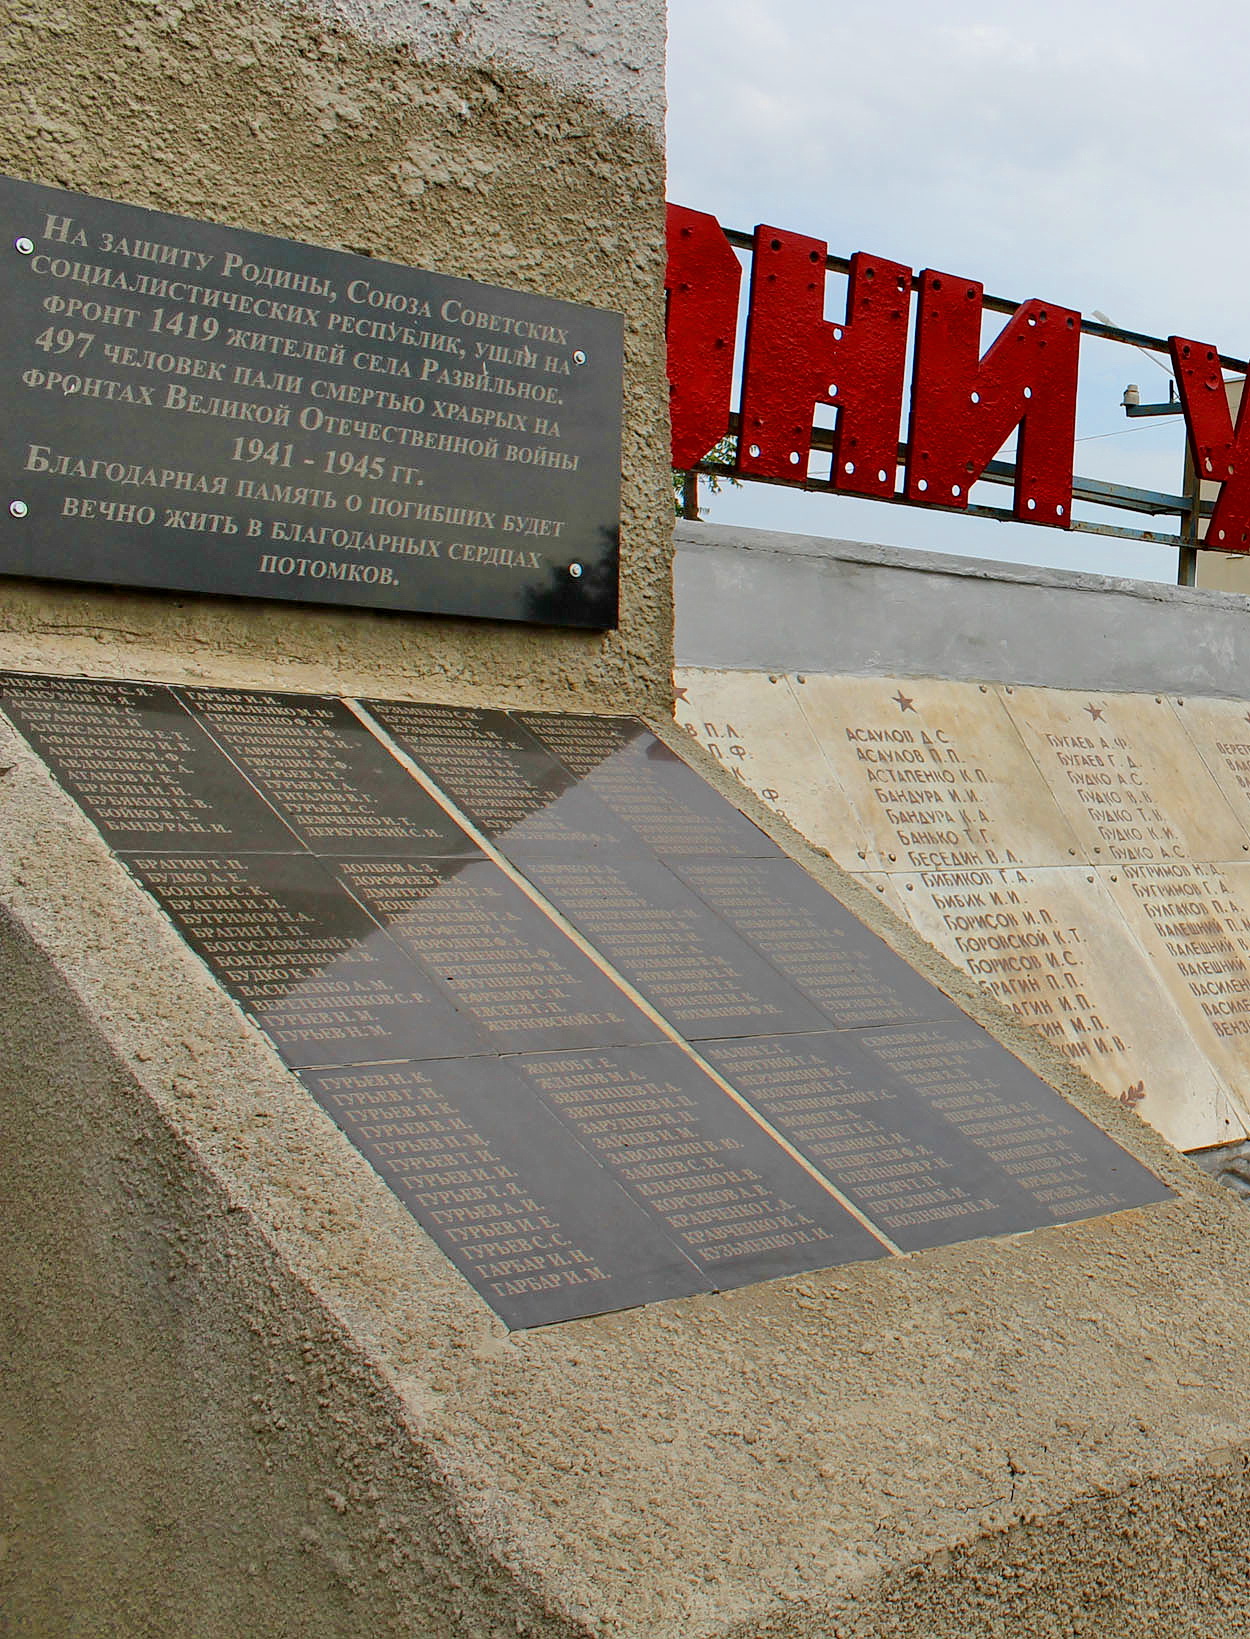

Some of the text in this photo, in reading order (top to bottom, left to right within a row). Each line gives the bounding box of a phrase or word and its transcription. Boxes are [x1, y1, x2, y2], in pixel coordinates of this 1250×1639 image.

[846, 728, 914, 743] АСАУЛОВ
[856, 748, 925, 763] АСАУЛОВ
[867, 768, 955, 783] АСТАПЕНКО
[875, 789, 943, 804] БАНДУРА
[886, 809, 955, 824] БАНДУРА
[897, 830, 958, 845] БАНЬКО
[908, 851, 983, 867] БЕСЕДИН
[921, 872, 993, 888] БИБИКОВ
[932, 893, 986, 909] БИБИК
[943, 912, 1019, 931] БОРИСОВ
[955, 929, 1048, 953] БОРОВСКОЙ
[967, 955, 1042, 975] БОРИСОВ
[979, 978, 1041, 998] БРАГИН
